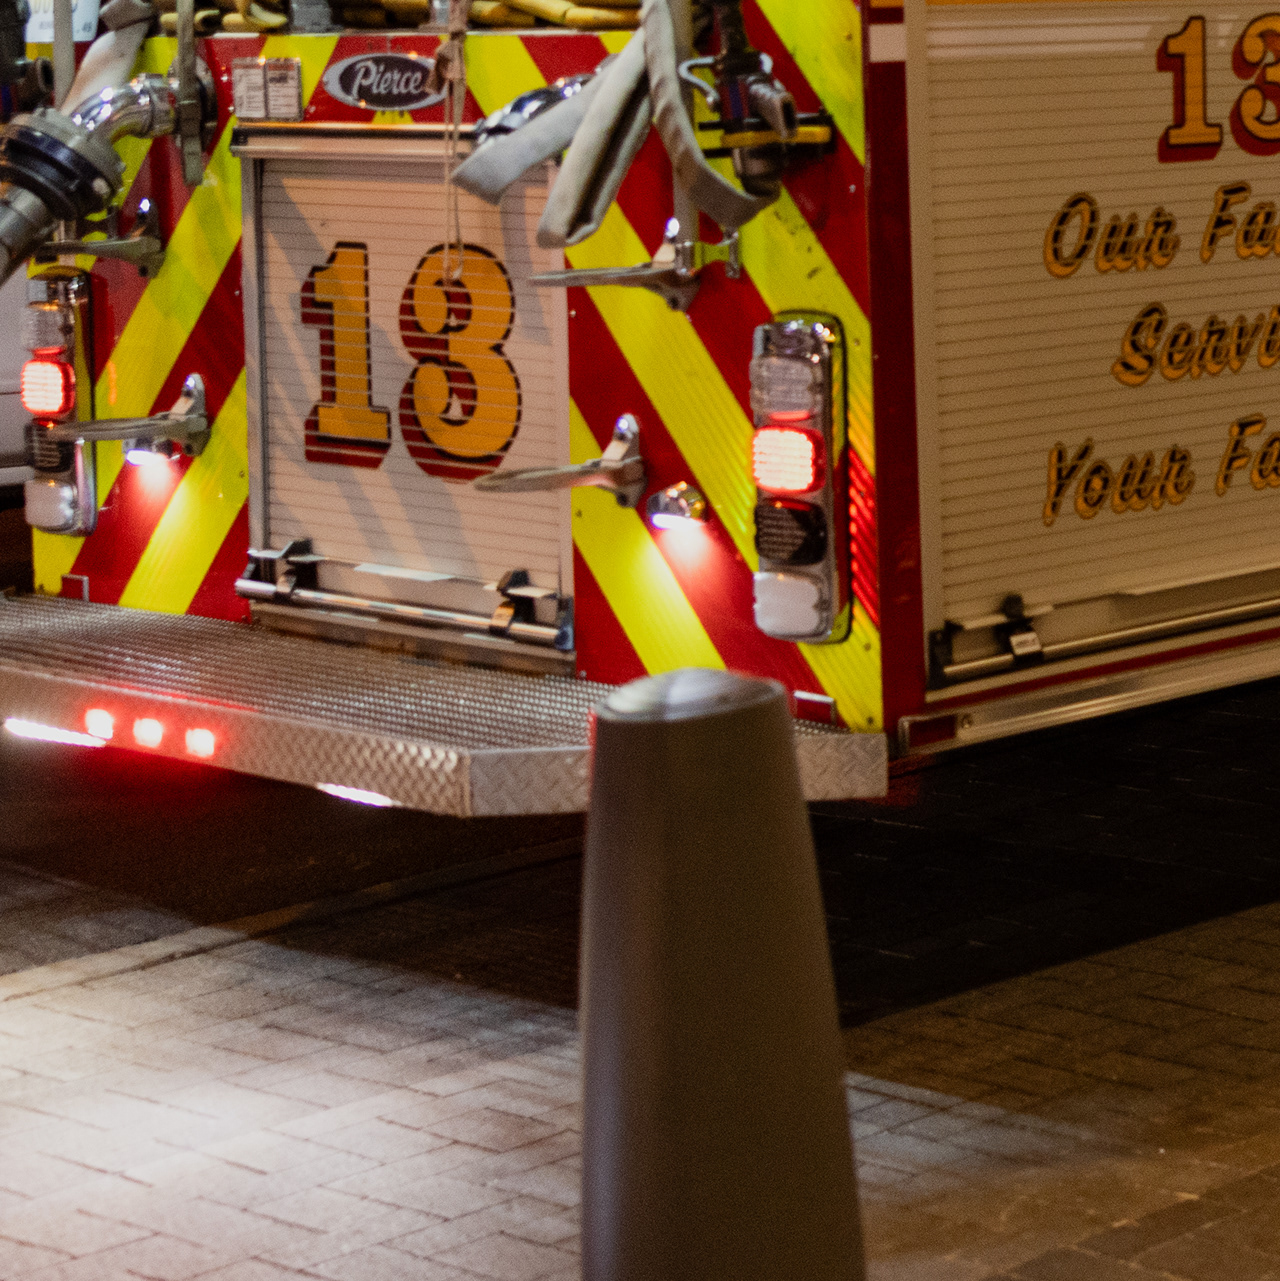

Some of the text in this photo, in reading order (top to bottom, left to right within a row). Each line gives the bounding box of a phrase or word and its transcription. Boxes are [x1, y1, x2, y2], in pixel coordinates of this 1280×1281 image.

[351, 59, 425, 101] Pierce
[1043, 191, 1181, 280] Our
[299, 240, 523, 486] 13
[1043, 436, 1196, 527] Your
